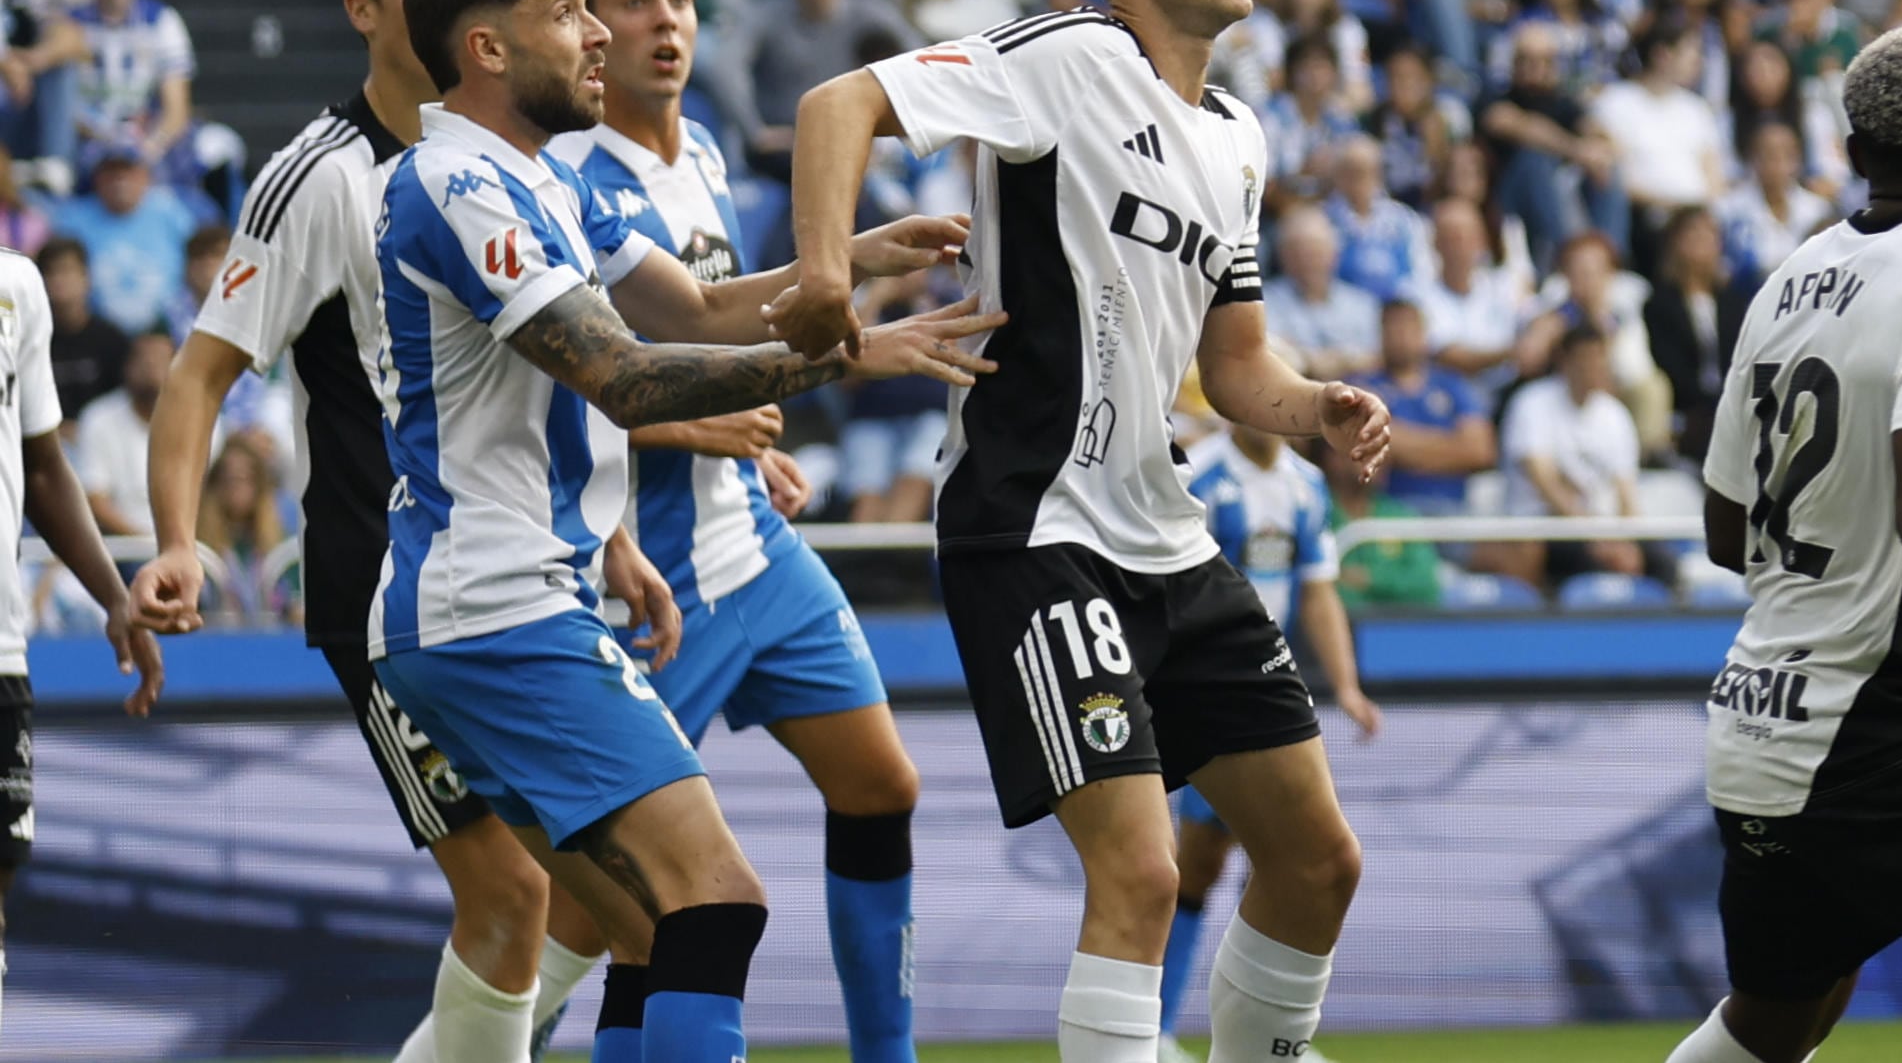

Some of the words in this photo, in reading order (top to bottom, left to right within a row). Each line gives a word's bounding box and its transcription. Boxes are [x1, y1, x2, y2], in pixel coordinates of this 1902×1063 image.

[1102, 284, 1114, 323] 2031
[1774, 267, 1865, 322] APPN
[1750, 356, 1840, 580] 12
[1048, 597, 1132, 680] 18
[1710, 657, 1809, 722] EROIL
